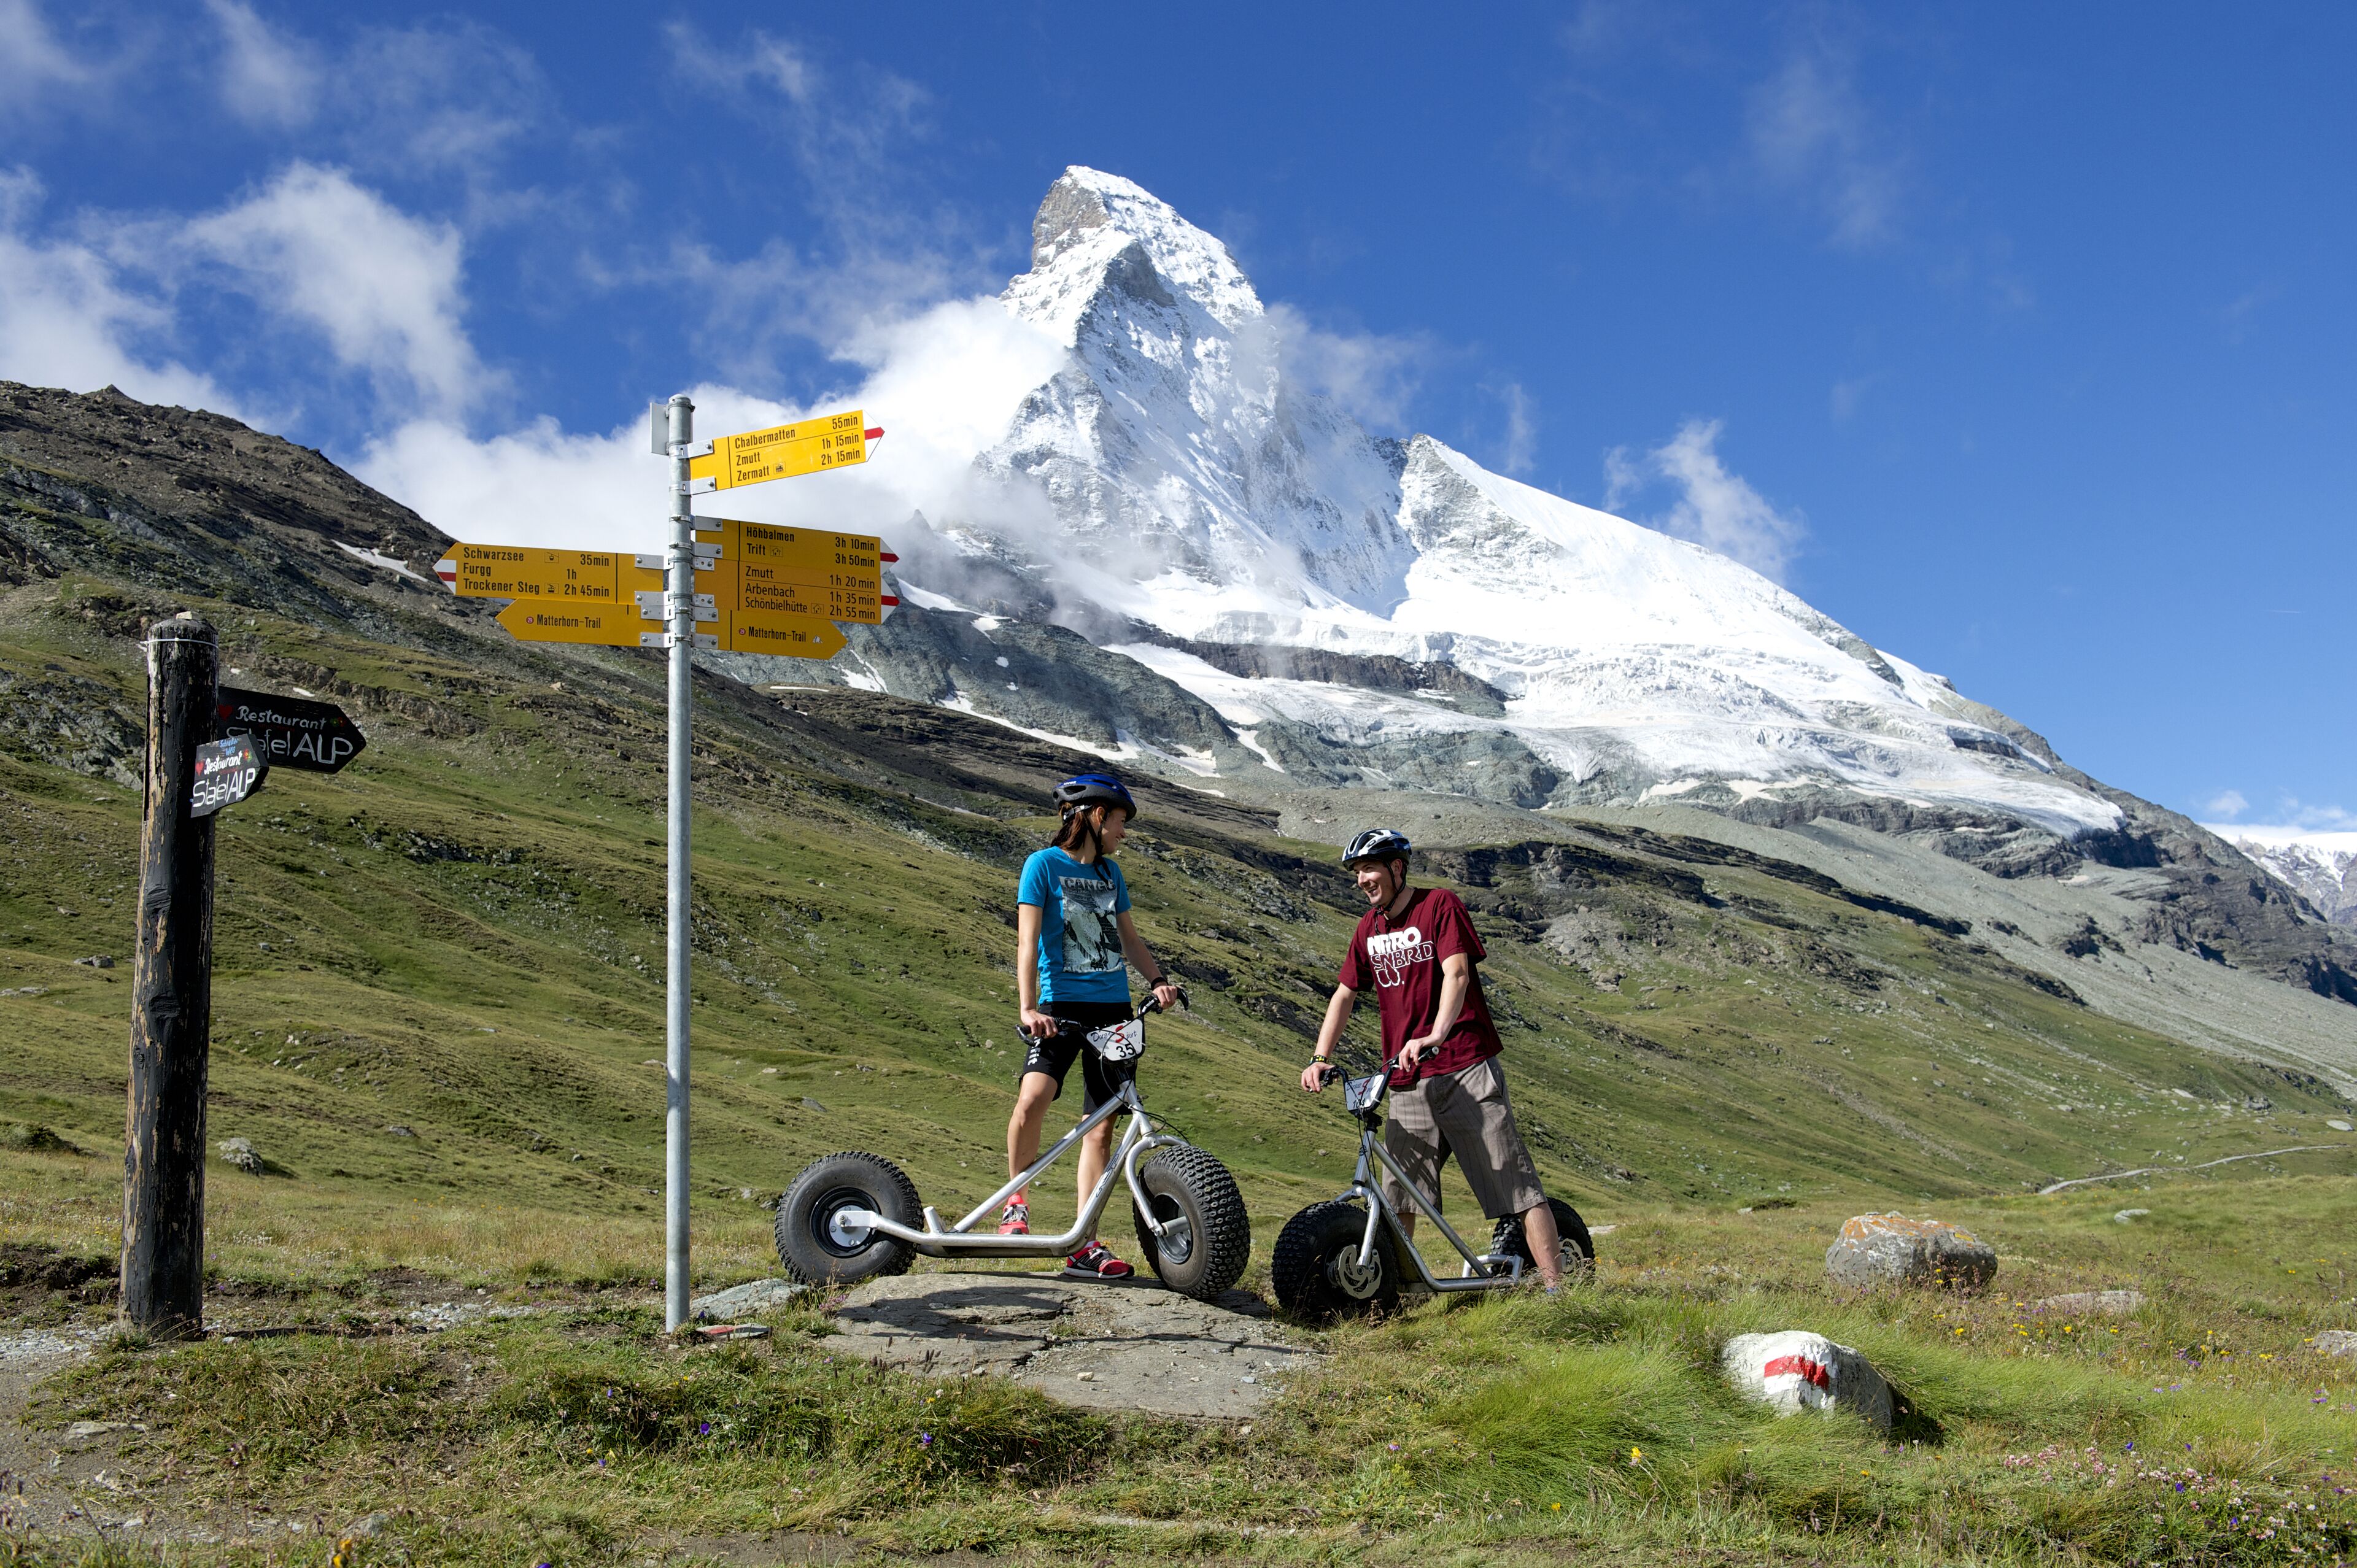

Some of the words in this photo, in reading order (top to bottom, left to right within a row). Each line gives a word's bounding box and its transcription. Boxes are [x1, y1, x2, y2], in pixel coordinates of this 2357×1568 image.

[735, 429, 795, 449] Chalbermatten
[832, 415, 858, 430] 55min
[737, 452, 761, 466] Zmutt
[822, 438, 830, 449] 1h
[836, 433, 859, 447] 15min
[737, 465, 770, 481] Zermatt
[821, 453, 832, 465] 2h
[837, 449, 861, 462] 15min
[746, 527, 794, 542] Höhbalmen
[851, 538, 875, 551] 10min
[463, 547, 524, 562] Schwarzsee
[580, 554, 610, 566] 35min
[747, 543, 765, 555] Trift
[849, 555, 875, 567] 50min
[463, 563, 491, 576] Furgg
[567, 568, 577, 580] 1h
[746, 566, 774, 579] Zmutt
[845, 576, 856, 587] 20
[859, 577, 875, 589] min
[463, 578, 513, 592] Trockener
[517, 581, 540, 595] Steg
[580, 585, 610, 597] 45min
[745, 583, 795, 598] Arbenbach
[845, 593, 856, 604] 35
[859, 594, 875, 606] min
[745, 597, 808, 613] Schönbielhütte
[846, 607, 856, 618] 55
[859, 608, 875, 619] min
[537, 614, 601, 628] Matterhorn-Trail
[748, 626, 807, 642] Matterhorn-Trail
[236, 706, 328, 730] Restaurant
[204, 750, 243, 774] Restaurant
[1367, 927, 1422, 956] NITRO
[1116, 1043, 1135, 1058] 35
